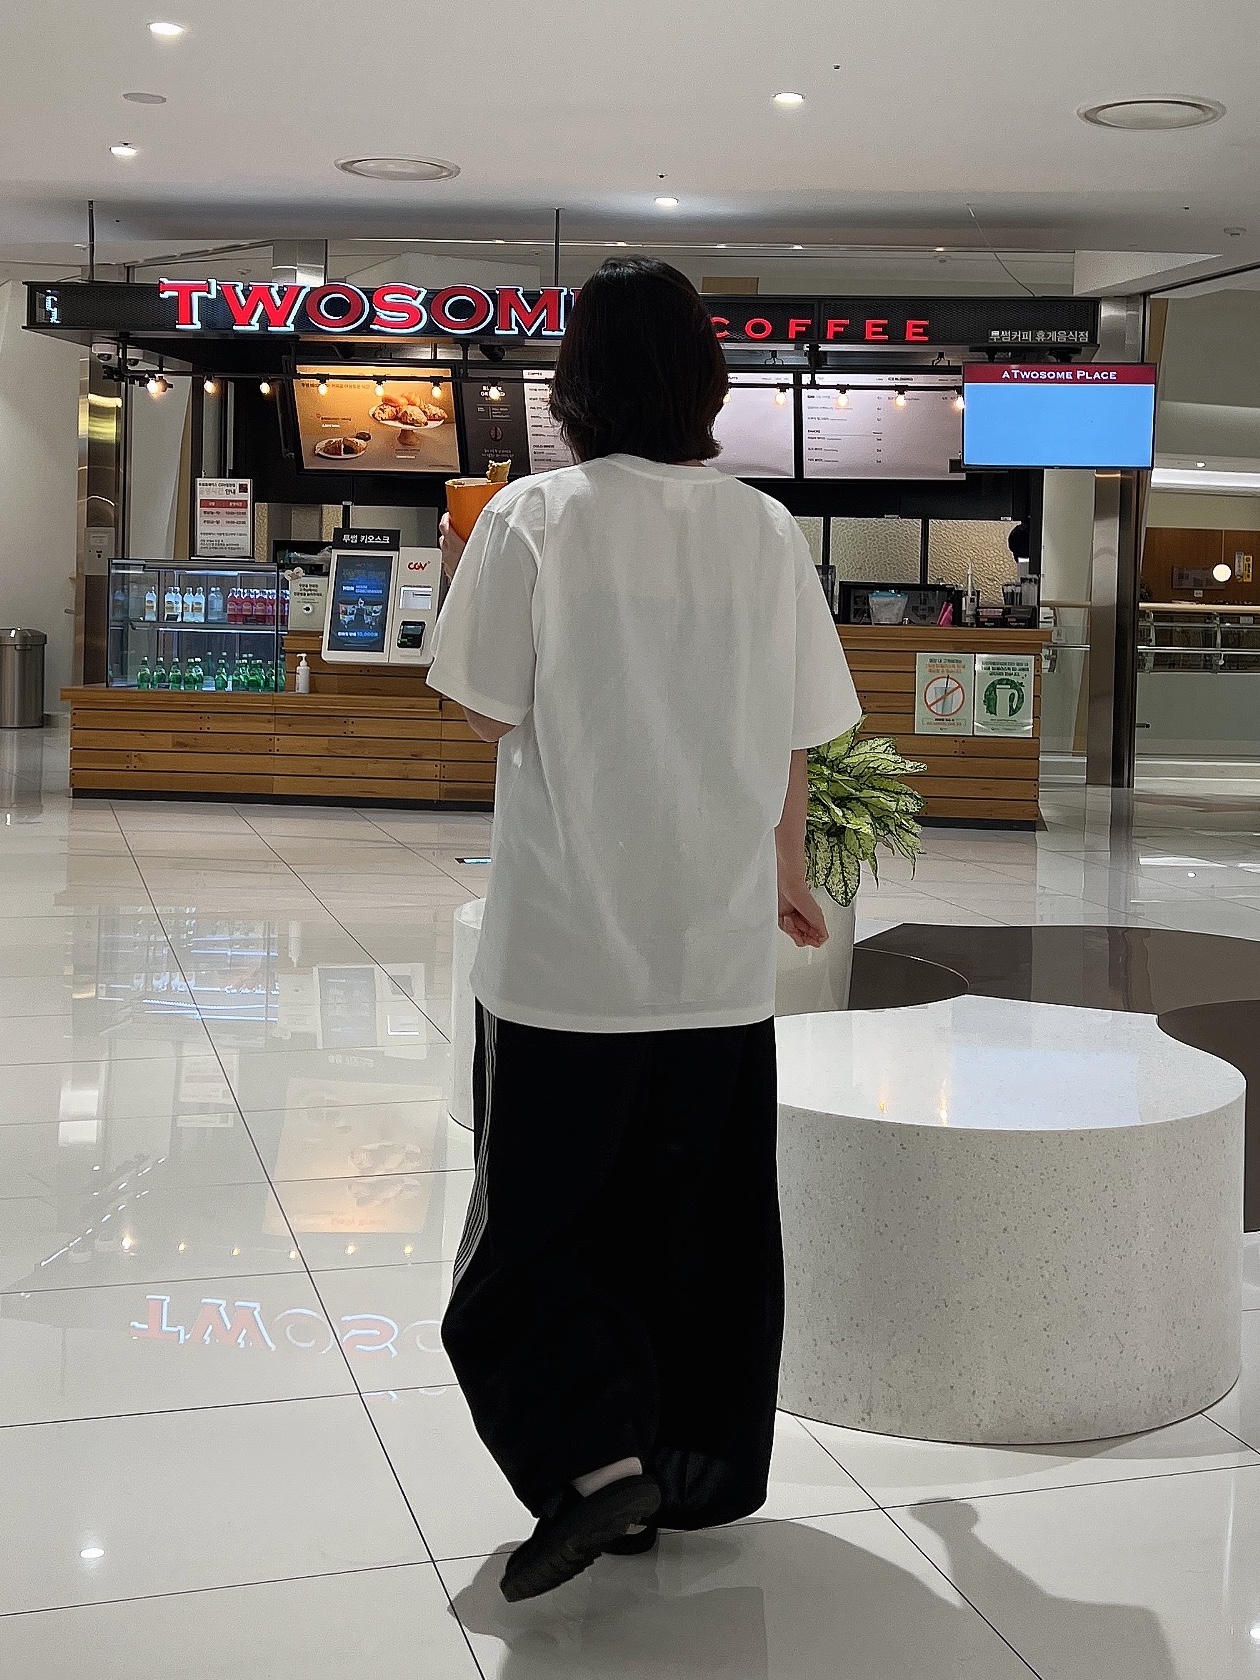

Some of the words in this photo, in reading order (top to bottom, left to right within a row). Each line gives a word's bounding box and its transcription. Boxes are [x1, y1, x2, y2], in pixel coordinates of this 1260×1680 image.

[158, 277, 583, 337] TWOSOM
[1035, 330, 1089, 343] 휴게음식점
[1002, 370, 1010, 379] A
[1077, 370, 1117, 380] PLACE
[360, 534, 390, 544] 키오스크
[407, 561, 427, 571] CGV
